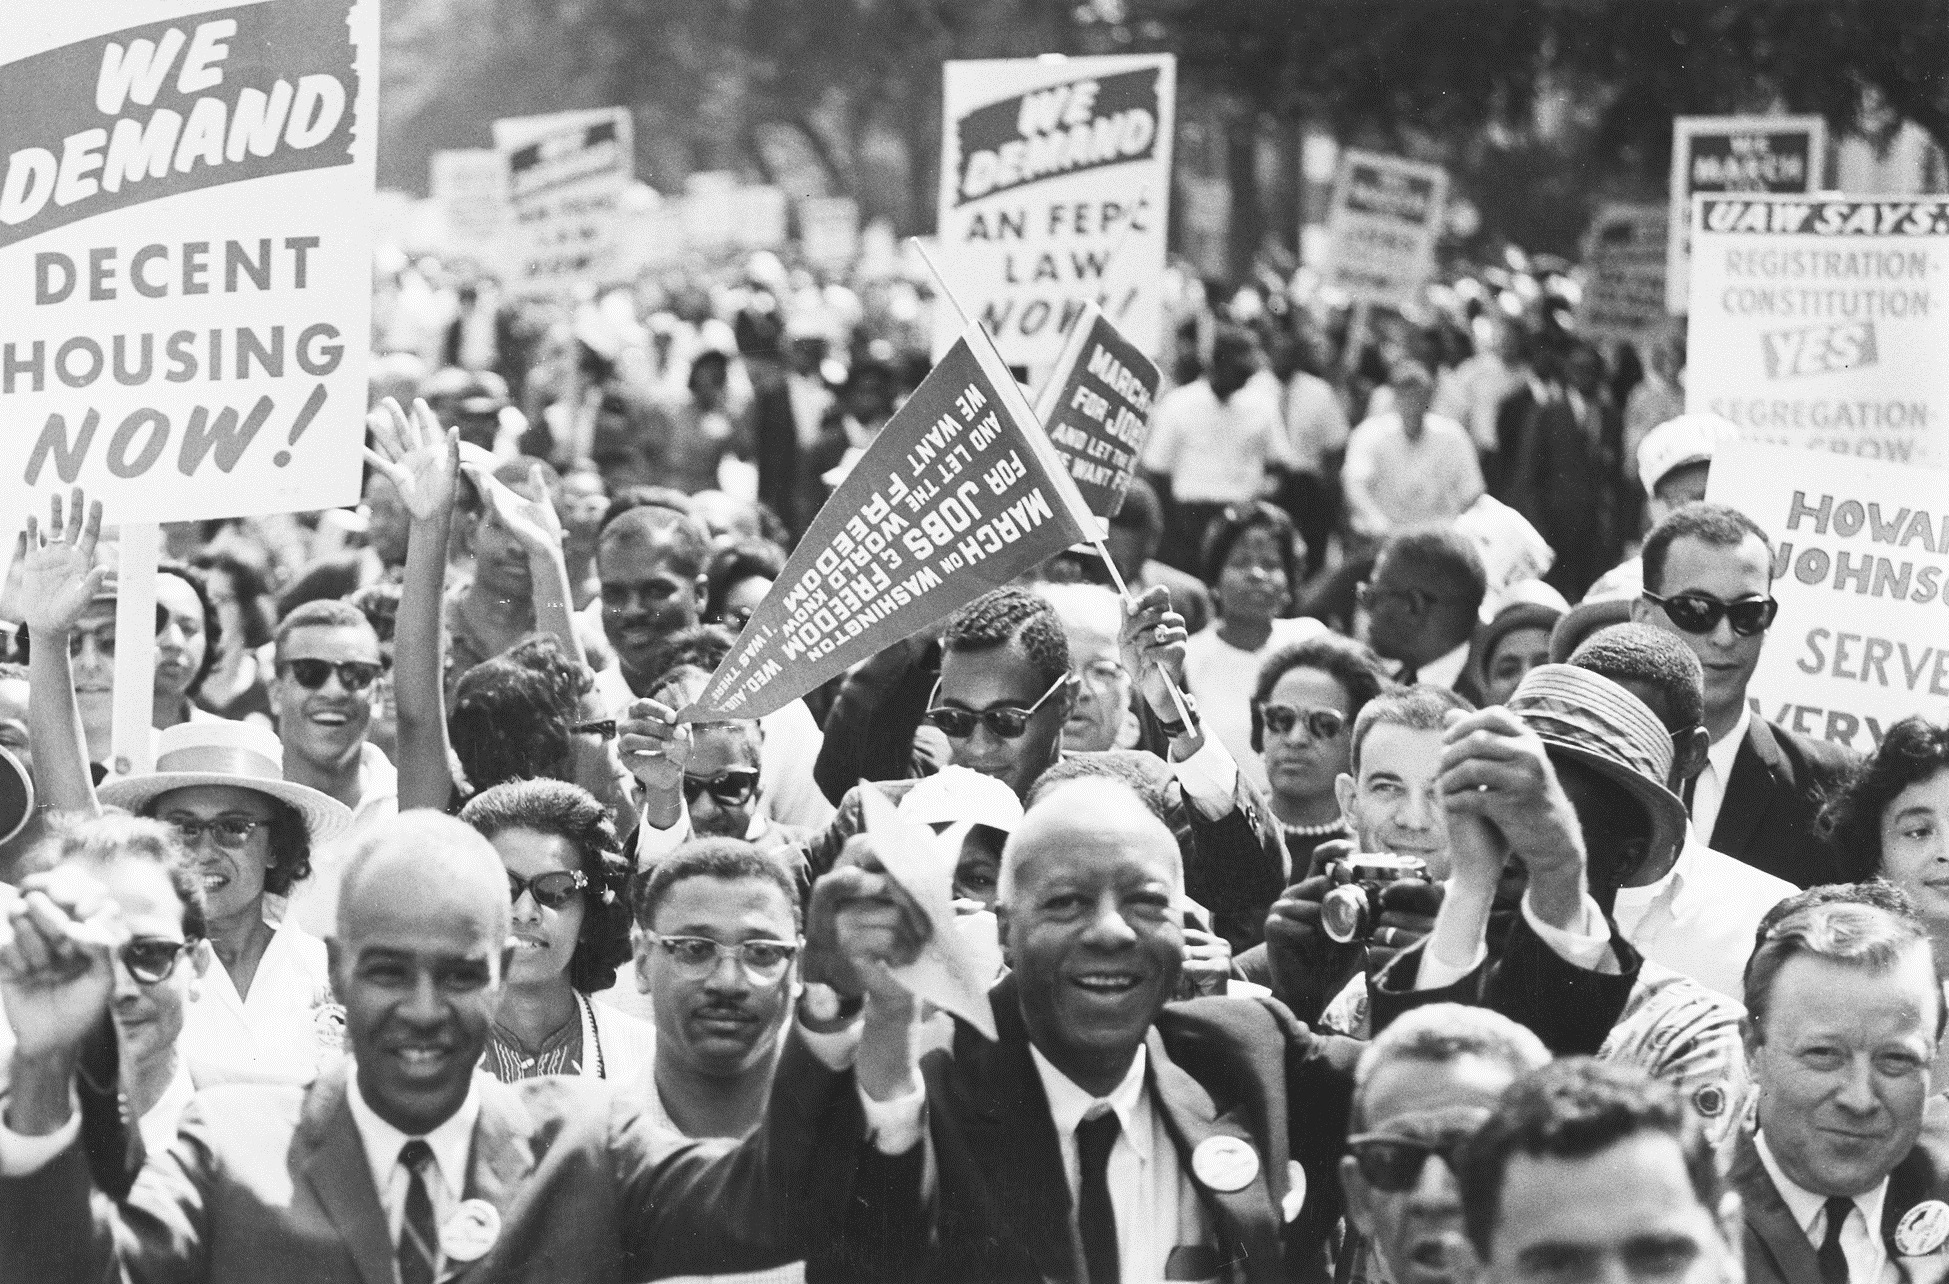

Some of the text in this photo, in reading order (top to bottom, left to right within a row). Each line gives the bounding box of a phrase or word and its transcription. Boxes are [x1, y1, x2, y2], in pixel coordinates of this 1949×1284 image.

[96, 18, 237, 115] WE
[1017, 81, 1100, 138] WE
[0, 74, 346, 226] DEMAND
[963, 108, 1154, 197] DEMAND
[967, 209, 1026, 241] AN
[1710, 203, 1809, 234] UAW
[35, 236, 320, 305] DECENT
[1006, 252, 1111, 284] LAW
[1721, 286, 1931, 318] CONSTITUTION
[3, 323, 345, 394] HOUSING
[1770, 323, 1868, 375] YES
[23, 383, 328, 487] NOW!
[1071, 385, 1109, 422] FOR
[782, 383, 987, 613] WE WANT FREEDOM
[983, 449, 1027, 495] FOR
[782, 410, 1002, 638] AND LET THE WORLD KNOW
[902, 480, 982, 560] JOBS
[806, 487, 1054, 662] MARCH ON WASHINGTON
[1772, 542, 1949, 607] JOHNS
[781, 561, 892, 661] FREEDOM
[738, 634, 767, 668] WAS
